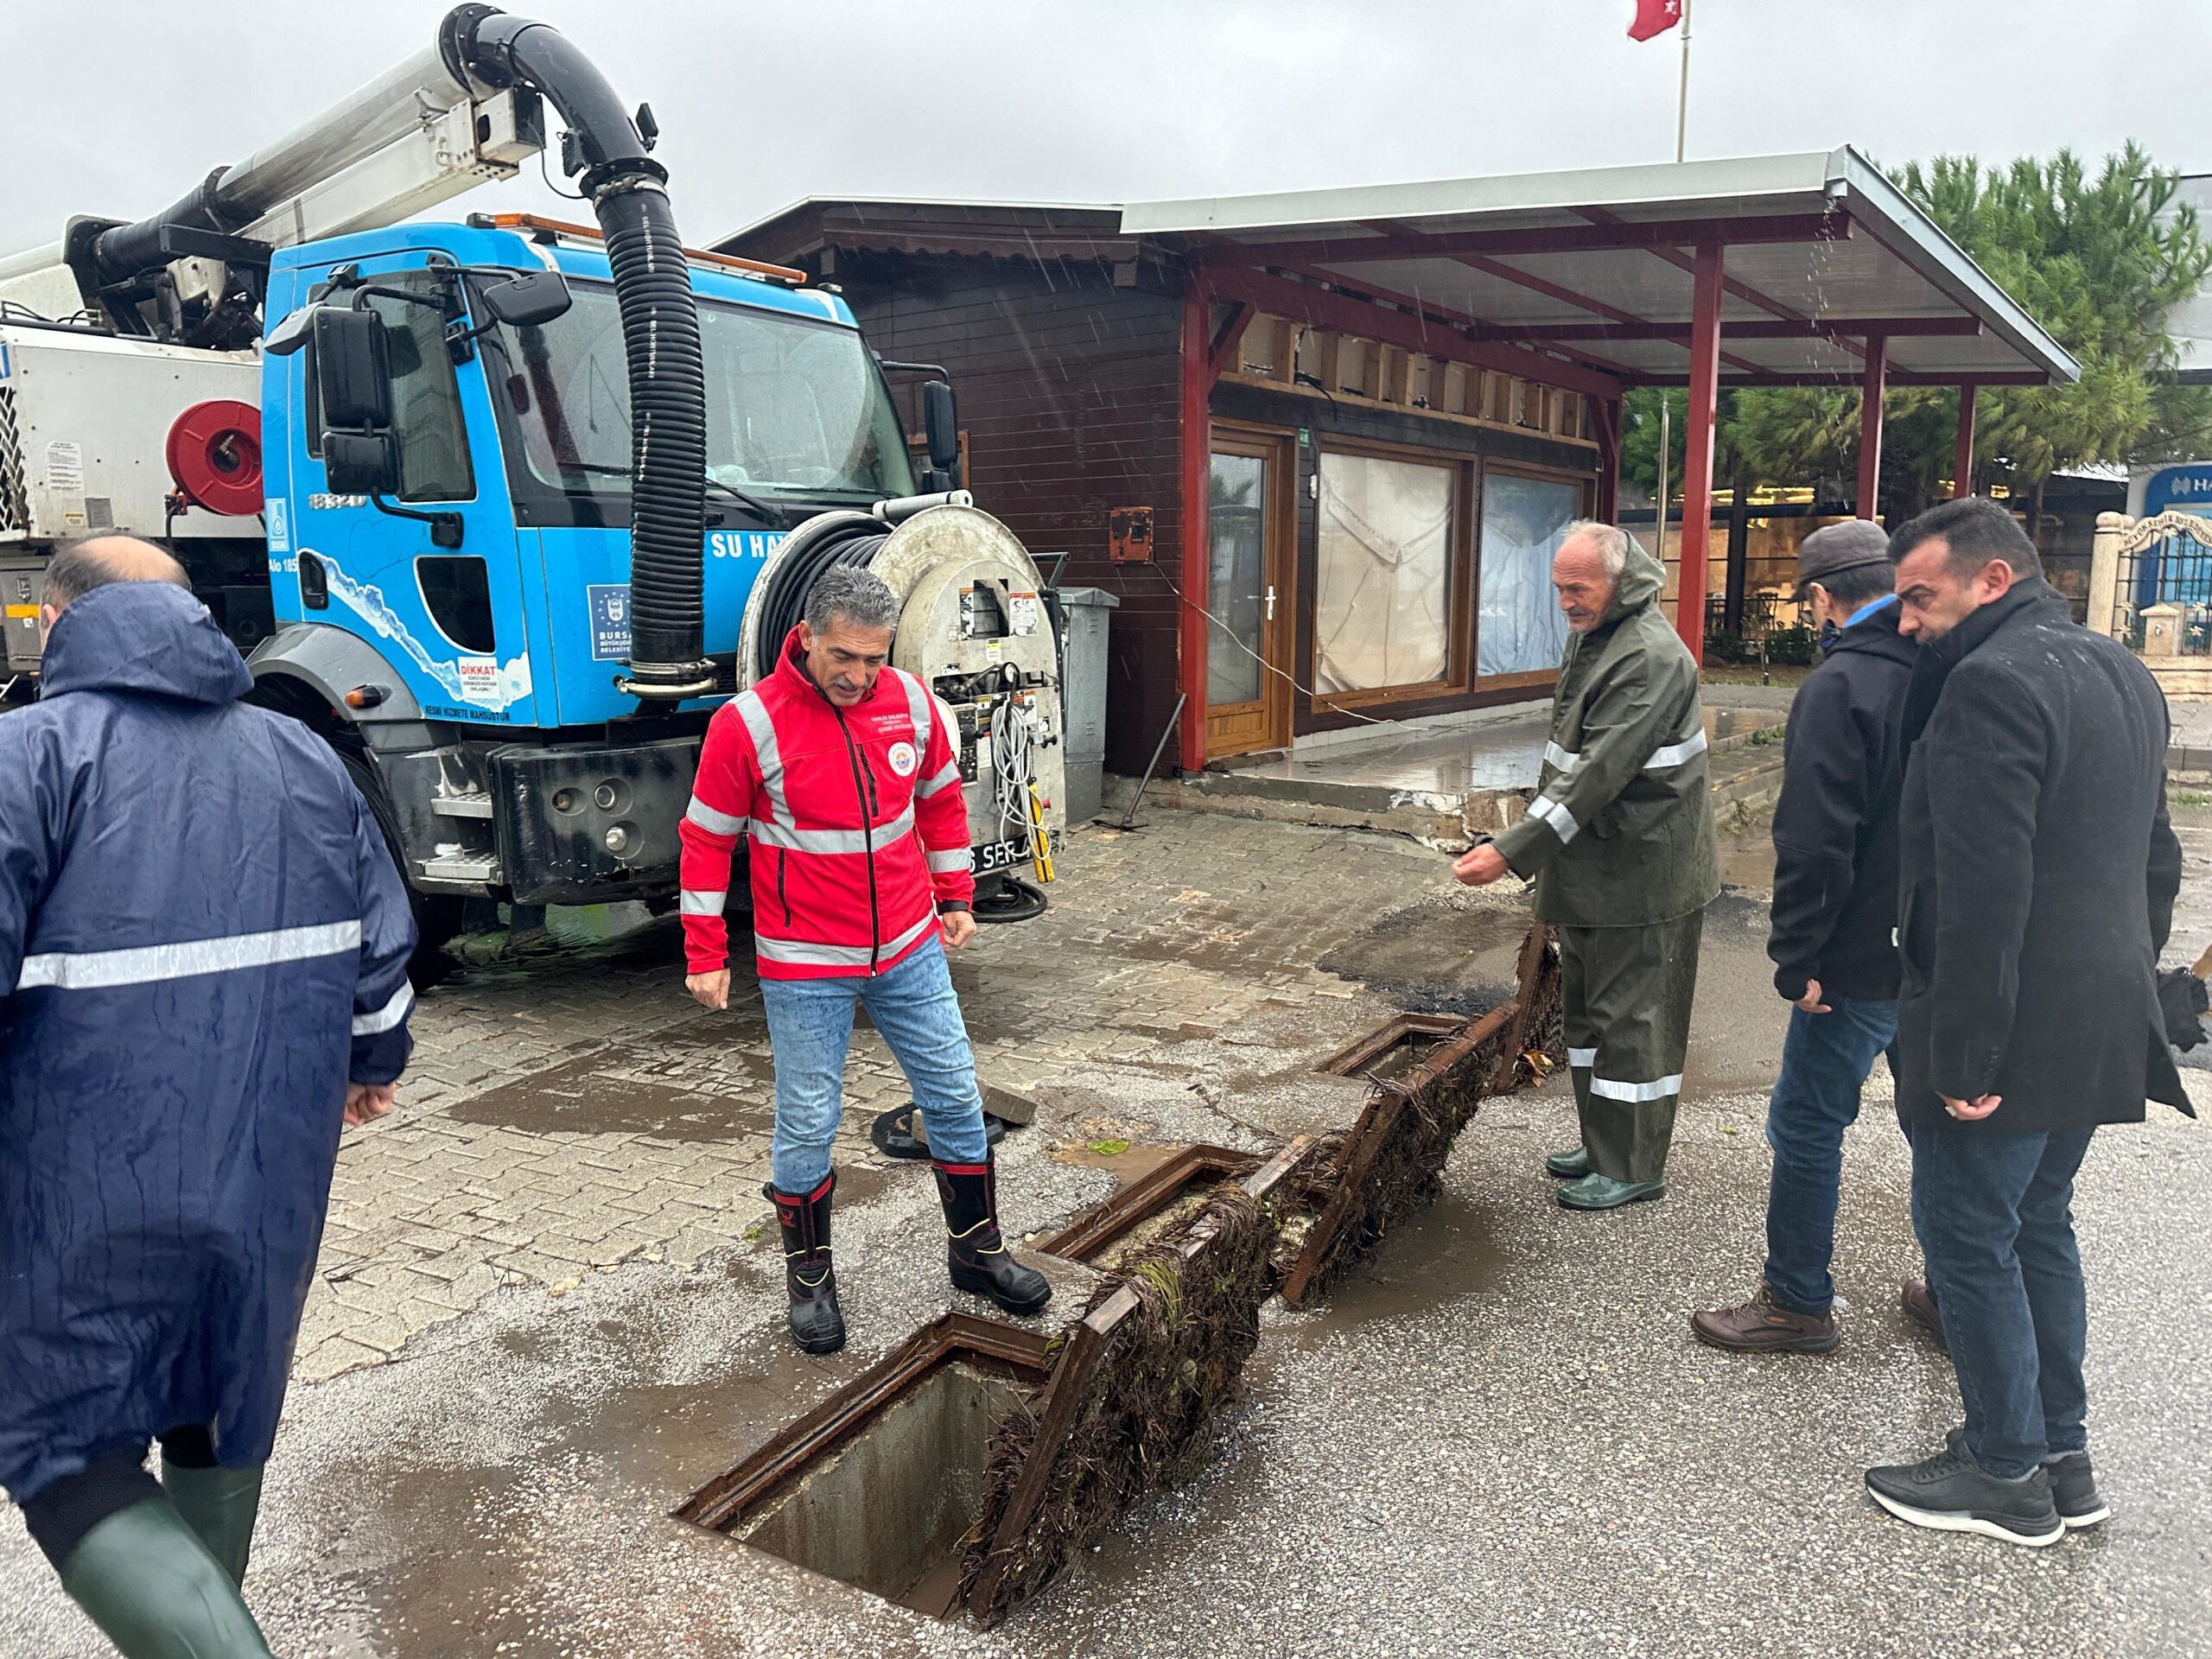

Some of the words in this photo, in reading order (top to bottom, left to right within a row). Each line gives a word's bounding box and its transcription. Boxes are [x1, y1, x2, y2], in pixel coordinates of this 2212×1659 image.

[710, 533, 743, 558] SU
[461, 664, 496, 675] DİKKAT
[982, 841, 1016, 868] SER
